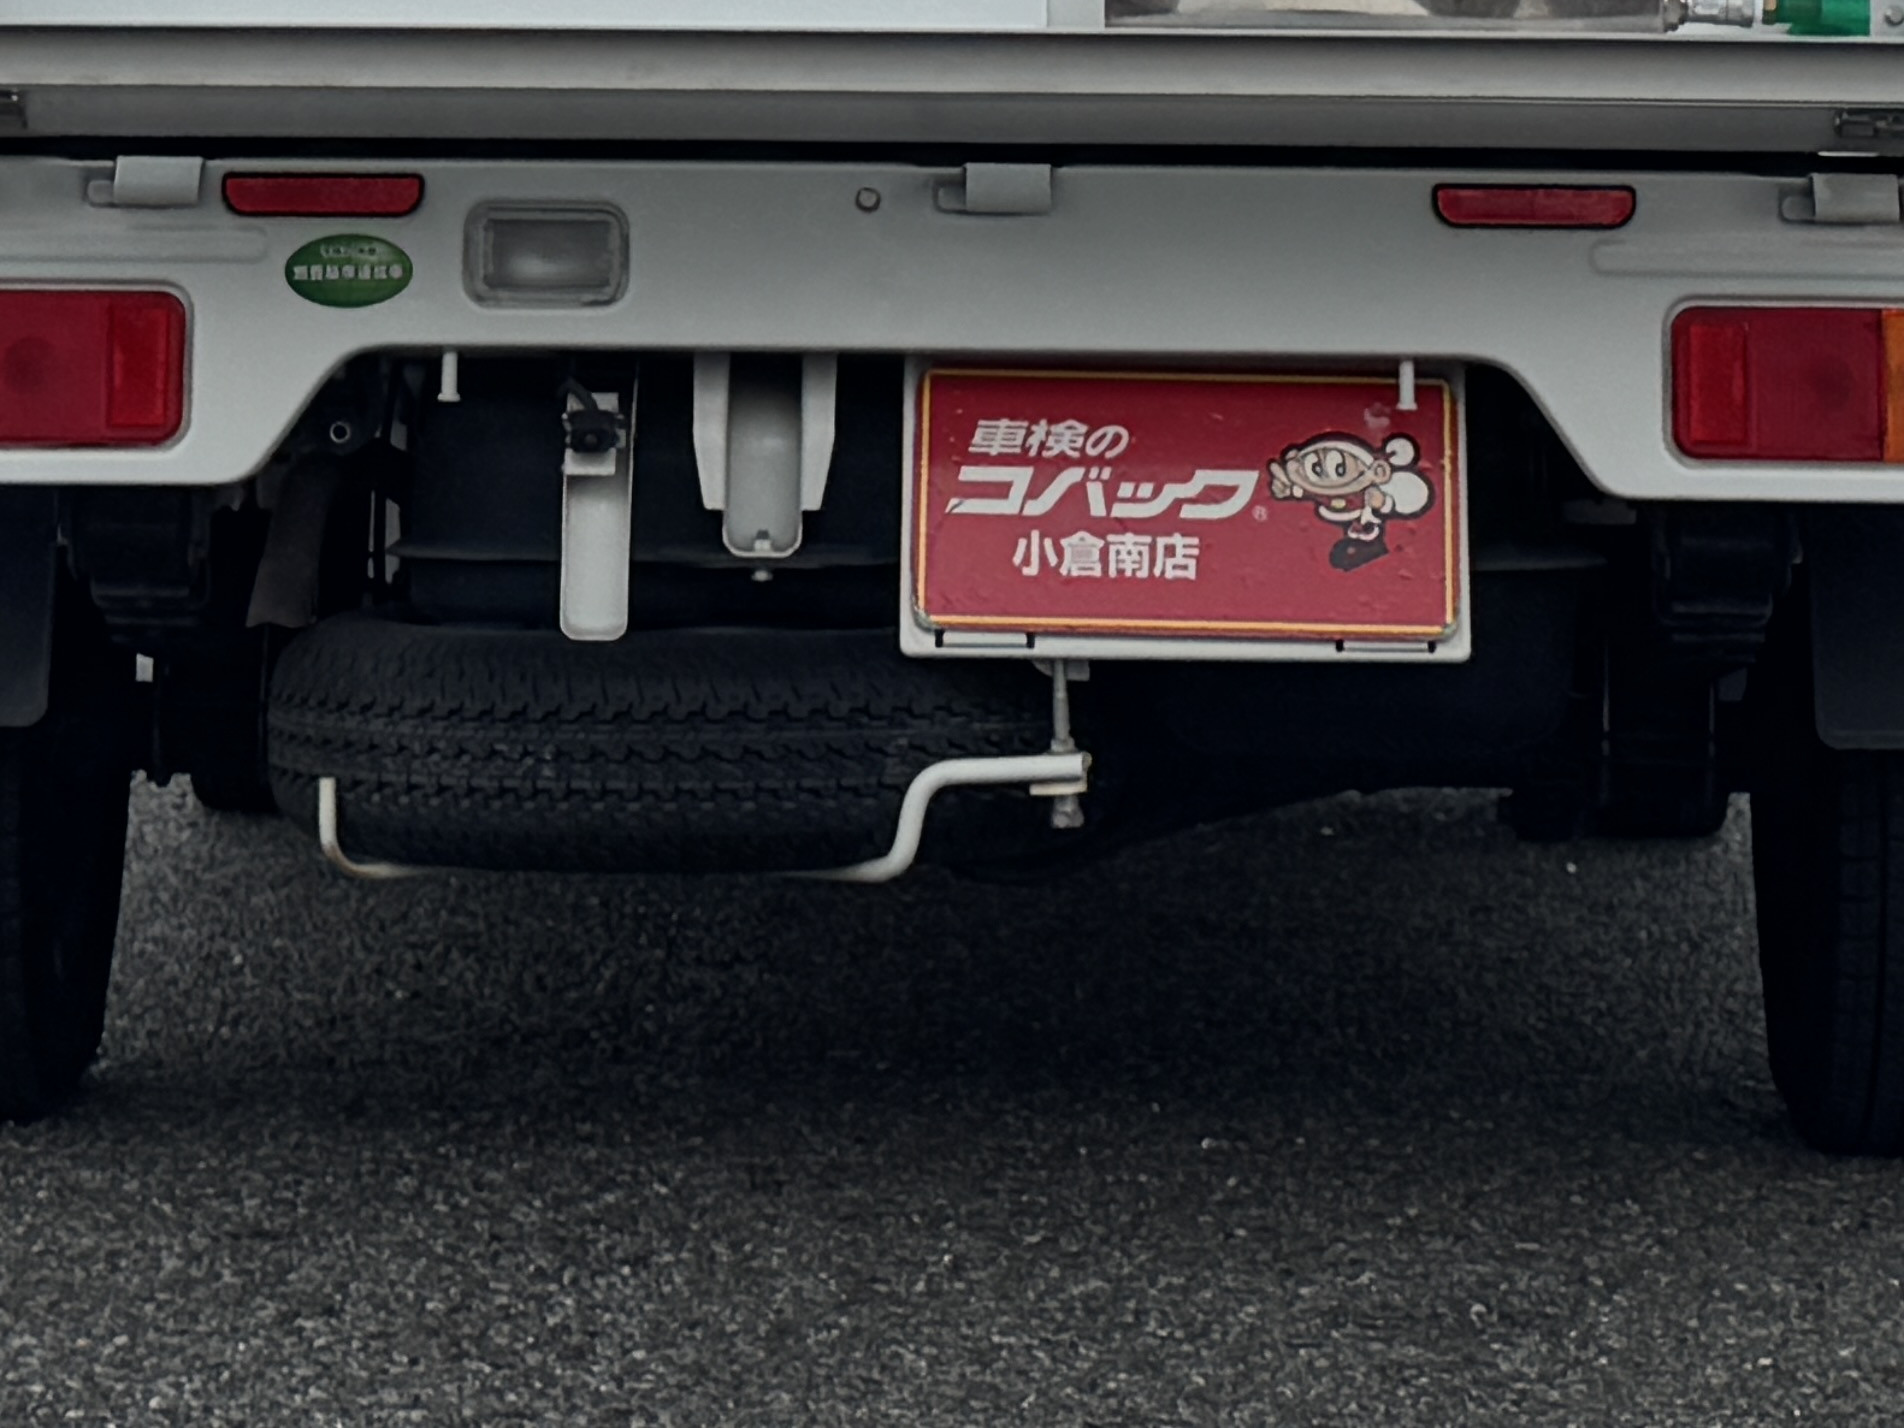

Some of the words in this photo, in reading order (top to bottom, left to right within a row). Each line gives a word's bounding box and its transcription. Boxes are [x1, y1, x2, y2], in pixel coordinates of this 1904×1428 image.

[968, 419, 1130, 459] 車検の
[945, 466, 1259, 520] コバック
[1012, 530, 1200, 580] 小倉南店
